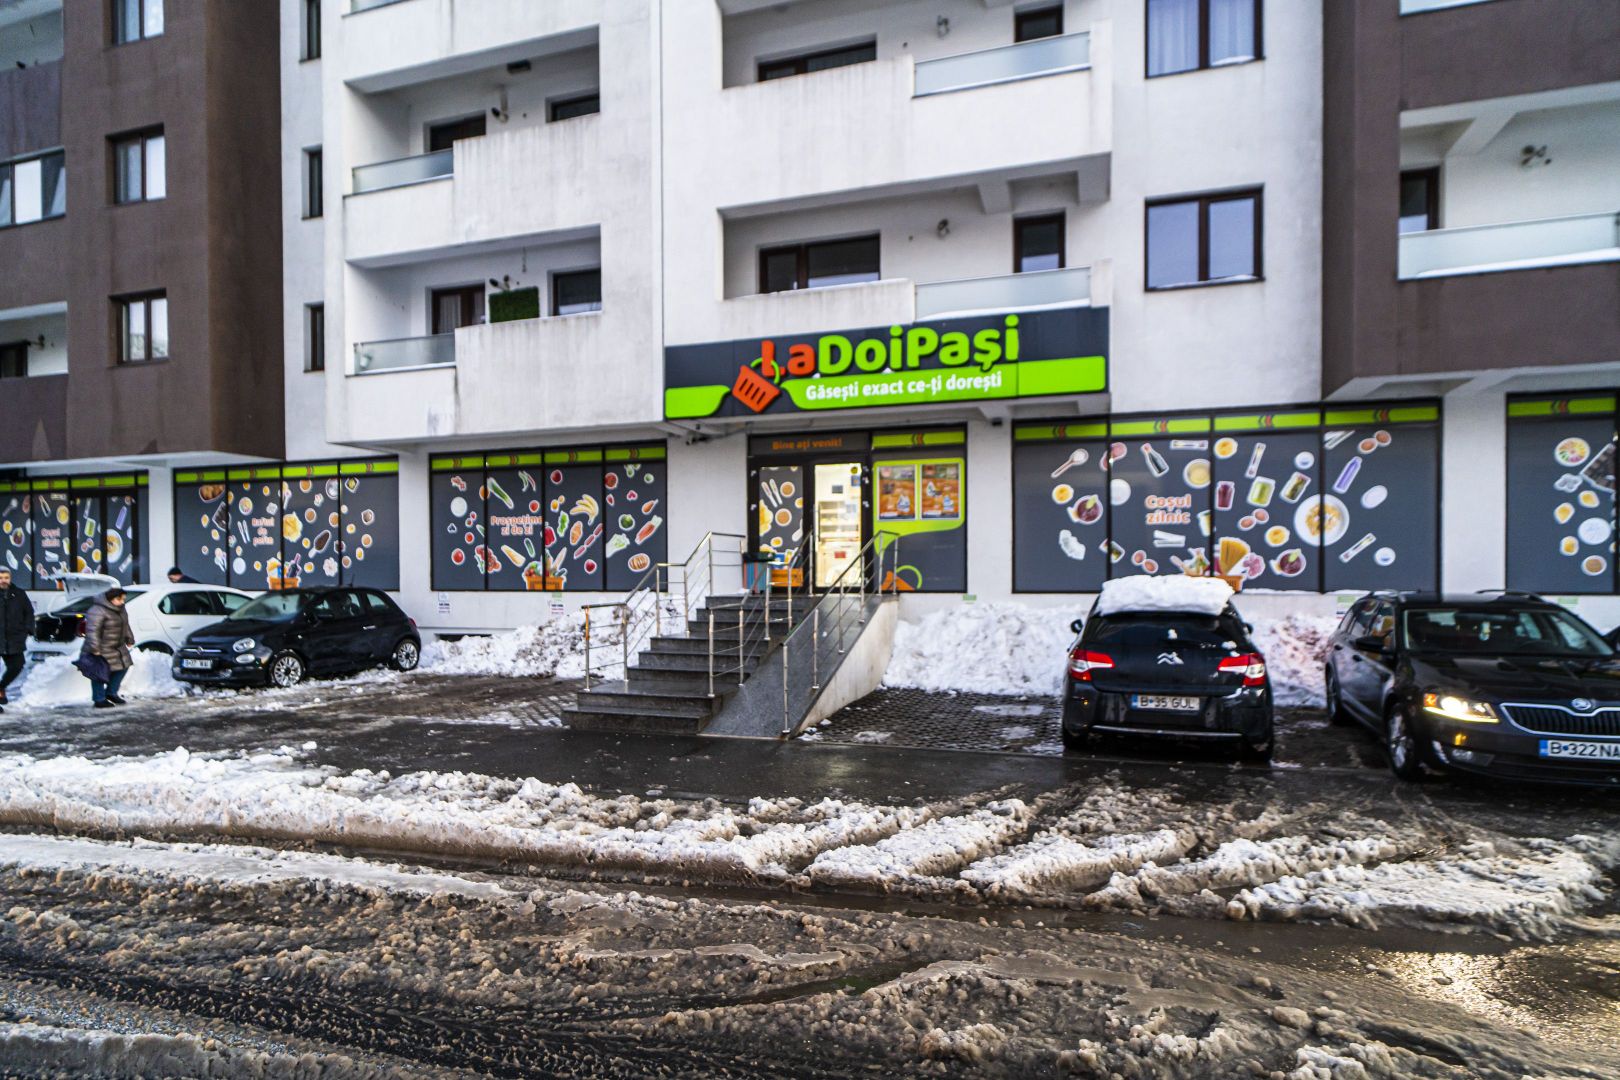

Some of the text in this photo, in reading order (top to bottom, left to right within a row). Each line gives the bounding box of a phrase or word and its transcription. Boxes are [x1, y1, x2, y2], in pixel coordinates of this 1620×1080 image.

[806, 370, 1002, 402] Găsești exact ce-ți dorești
[772, 440, 795, 450] Bine
[1145, 493, 1191, 511] Coșul
[1145, 509, 1191, 525] zilnic
[511, 525, 522, 535] de
